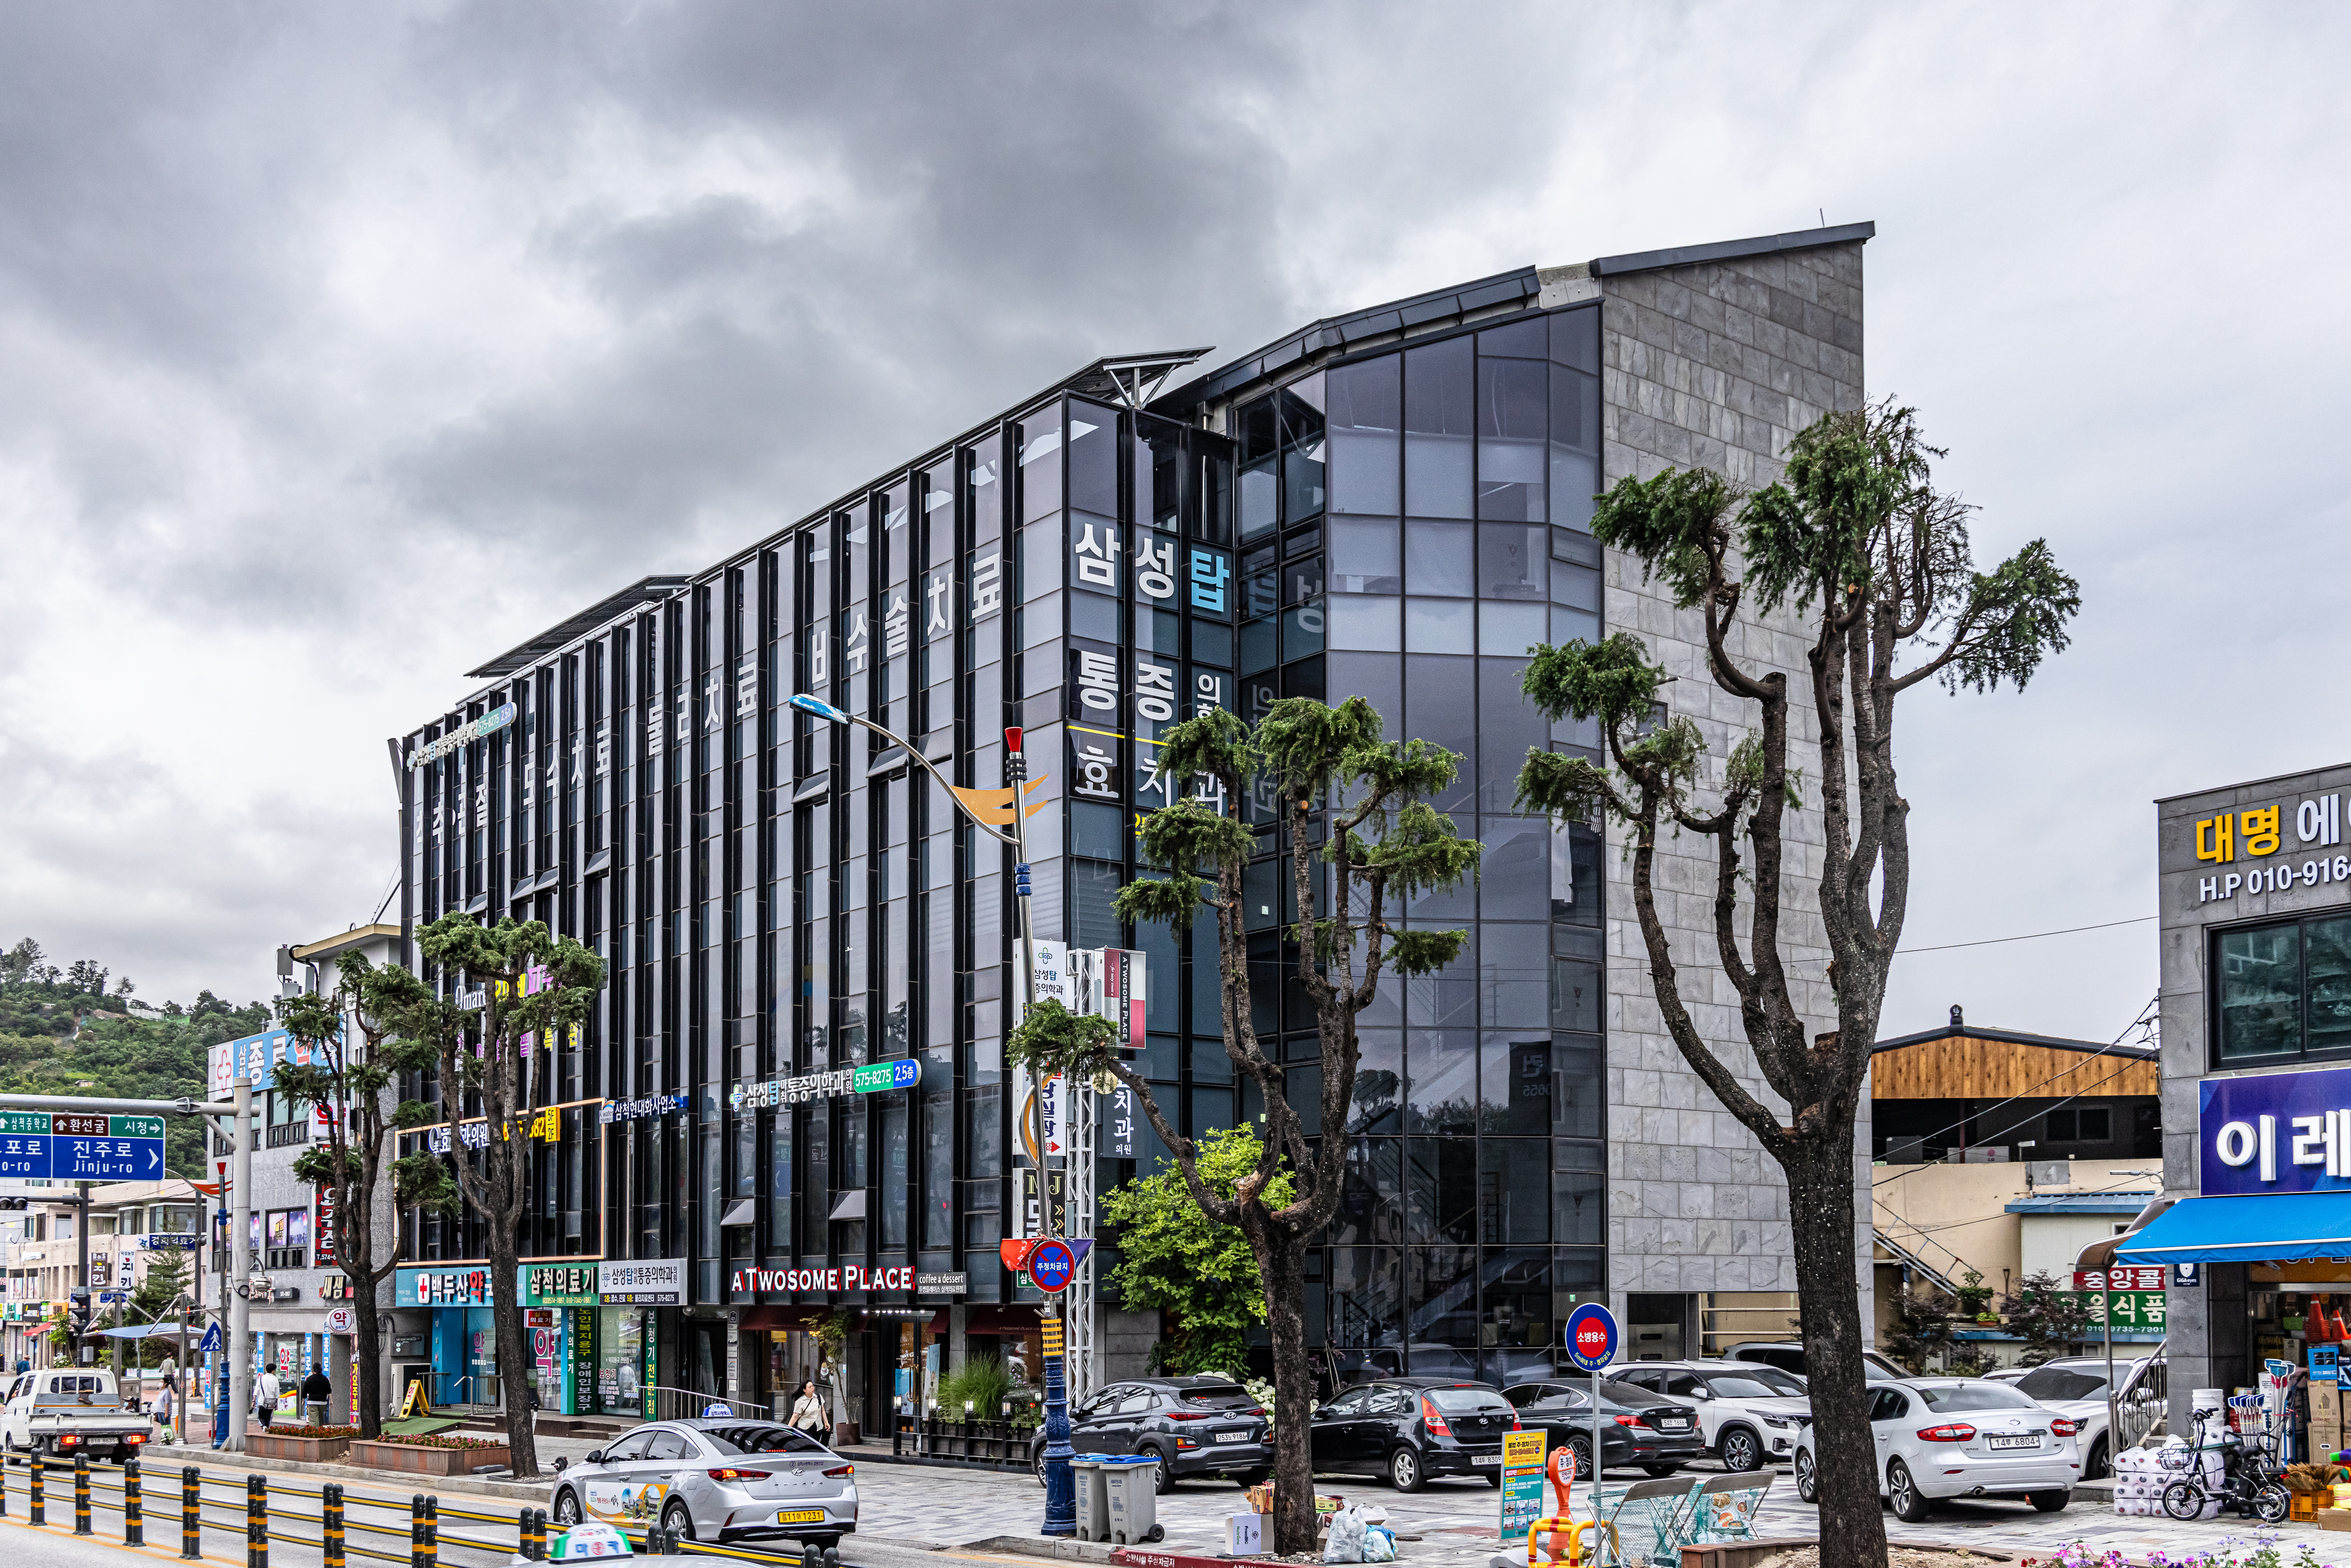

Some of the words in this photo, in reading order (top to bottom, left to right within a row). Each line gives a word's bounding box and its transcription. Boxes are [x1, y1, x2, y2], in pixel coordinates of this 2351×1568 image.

[1075, 523, 1230, 612] 삼성탑
[1079, 651, 1174, 721] 통증
[478, 713, 500, 732] 575-8275
[2196, 805, 2280, 863] 대명
[2297, 793, 2351, 846] 에
[2199, 873, 2242, 902] H.P
[1034, 969, 1057, 981] 삼성탑
[1035, 983, 1063, 995] 증의학과
[855, 1068, 892, 1087] 575-8275
[895, 1064, 915, 1083] 2,5층
[547, 1109, 554, 1122] 5F
[615, 1095, 677, 1121] 삼척현대화사업소
[11, 1117, 48, 1131] 삼척중학교
[69, 1118, 105, 1133] 환선굴
[125, 1121, 147, 1135] 시청
[440, 1123, 490, 1152] 효과의원
[547, 1127, 554, 1140] 2F
[0, 1140, 42, 1155] 포로
[73, 1141, 133, 1158] 진주로
[1116, 1143, 1131, 1155] 의원
[2216, 1108, 2351, 1182] 이레
[73, 1160, 133, 1174] Jinju-ro
[1037, 1262, 1068, 1271] 주정차금지
[530, 1267, 597, 1295] 삼척의료기
[731, 1271, 745, 1292] A
[745, 1267, 841, 1291] TWOSOME
[845, 1265, 915, 1291] PLACE
[919, 1274, 937, 1284] coffee
[942, 1274, 963, 1284] dessert
[657, 1294, 674, 1302] 575-8275
[333, 1312, 347, 1325] 약
[2087, 1325, 2164, 1333] 0109735-7901
[1577, 1332, 1606, 1343] 소방용수
[474, 1332, 485, 1359] 약
[534, 1328, 555, 1378] 약
[279, 1348, 290, 1380] 약
[599, 1368, 617, 1380] 보청기
[578, 1361, 592, 1411] 장애인보장구
[2015, 1437, 2035, 1446] 6804
[803, 1511, 820, 1520] 1231
